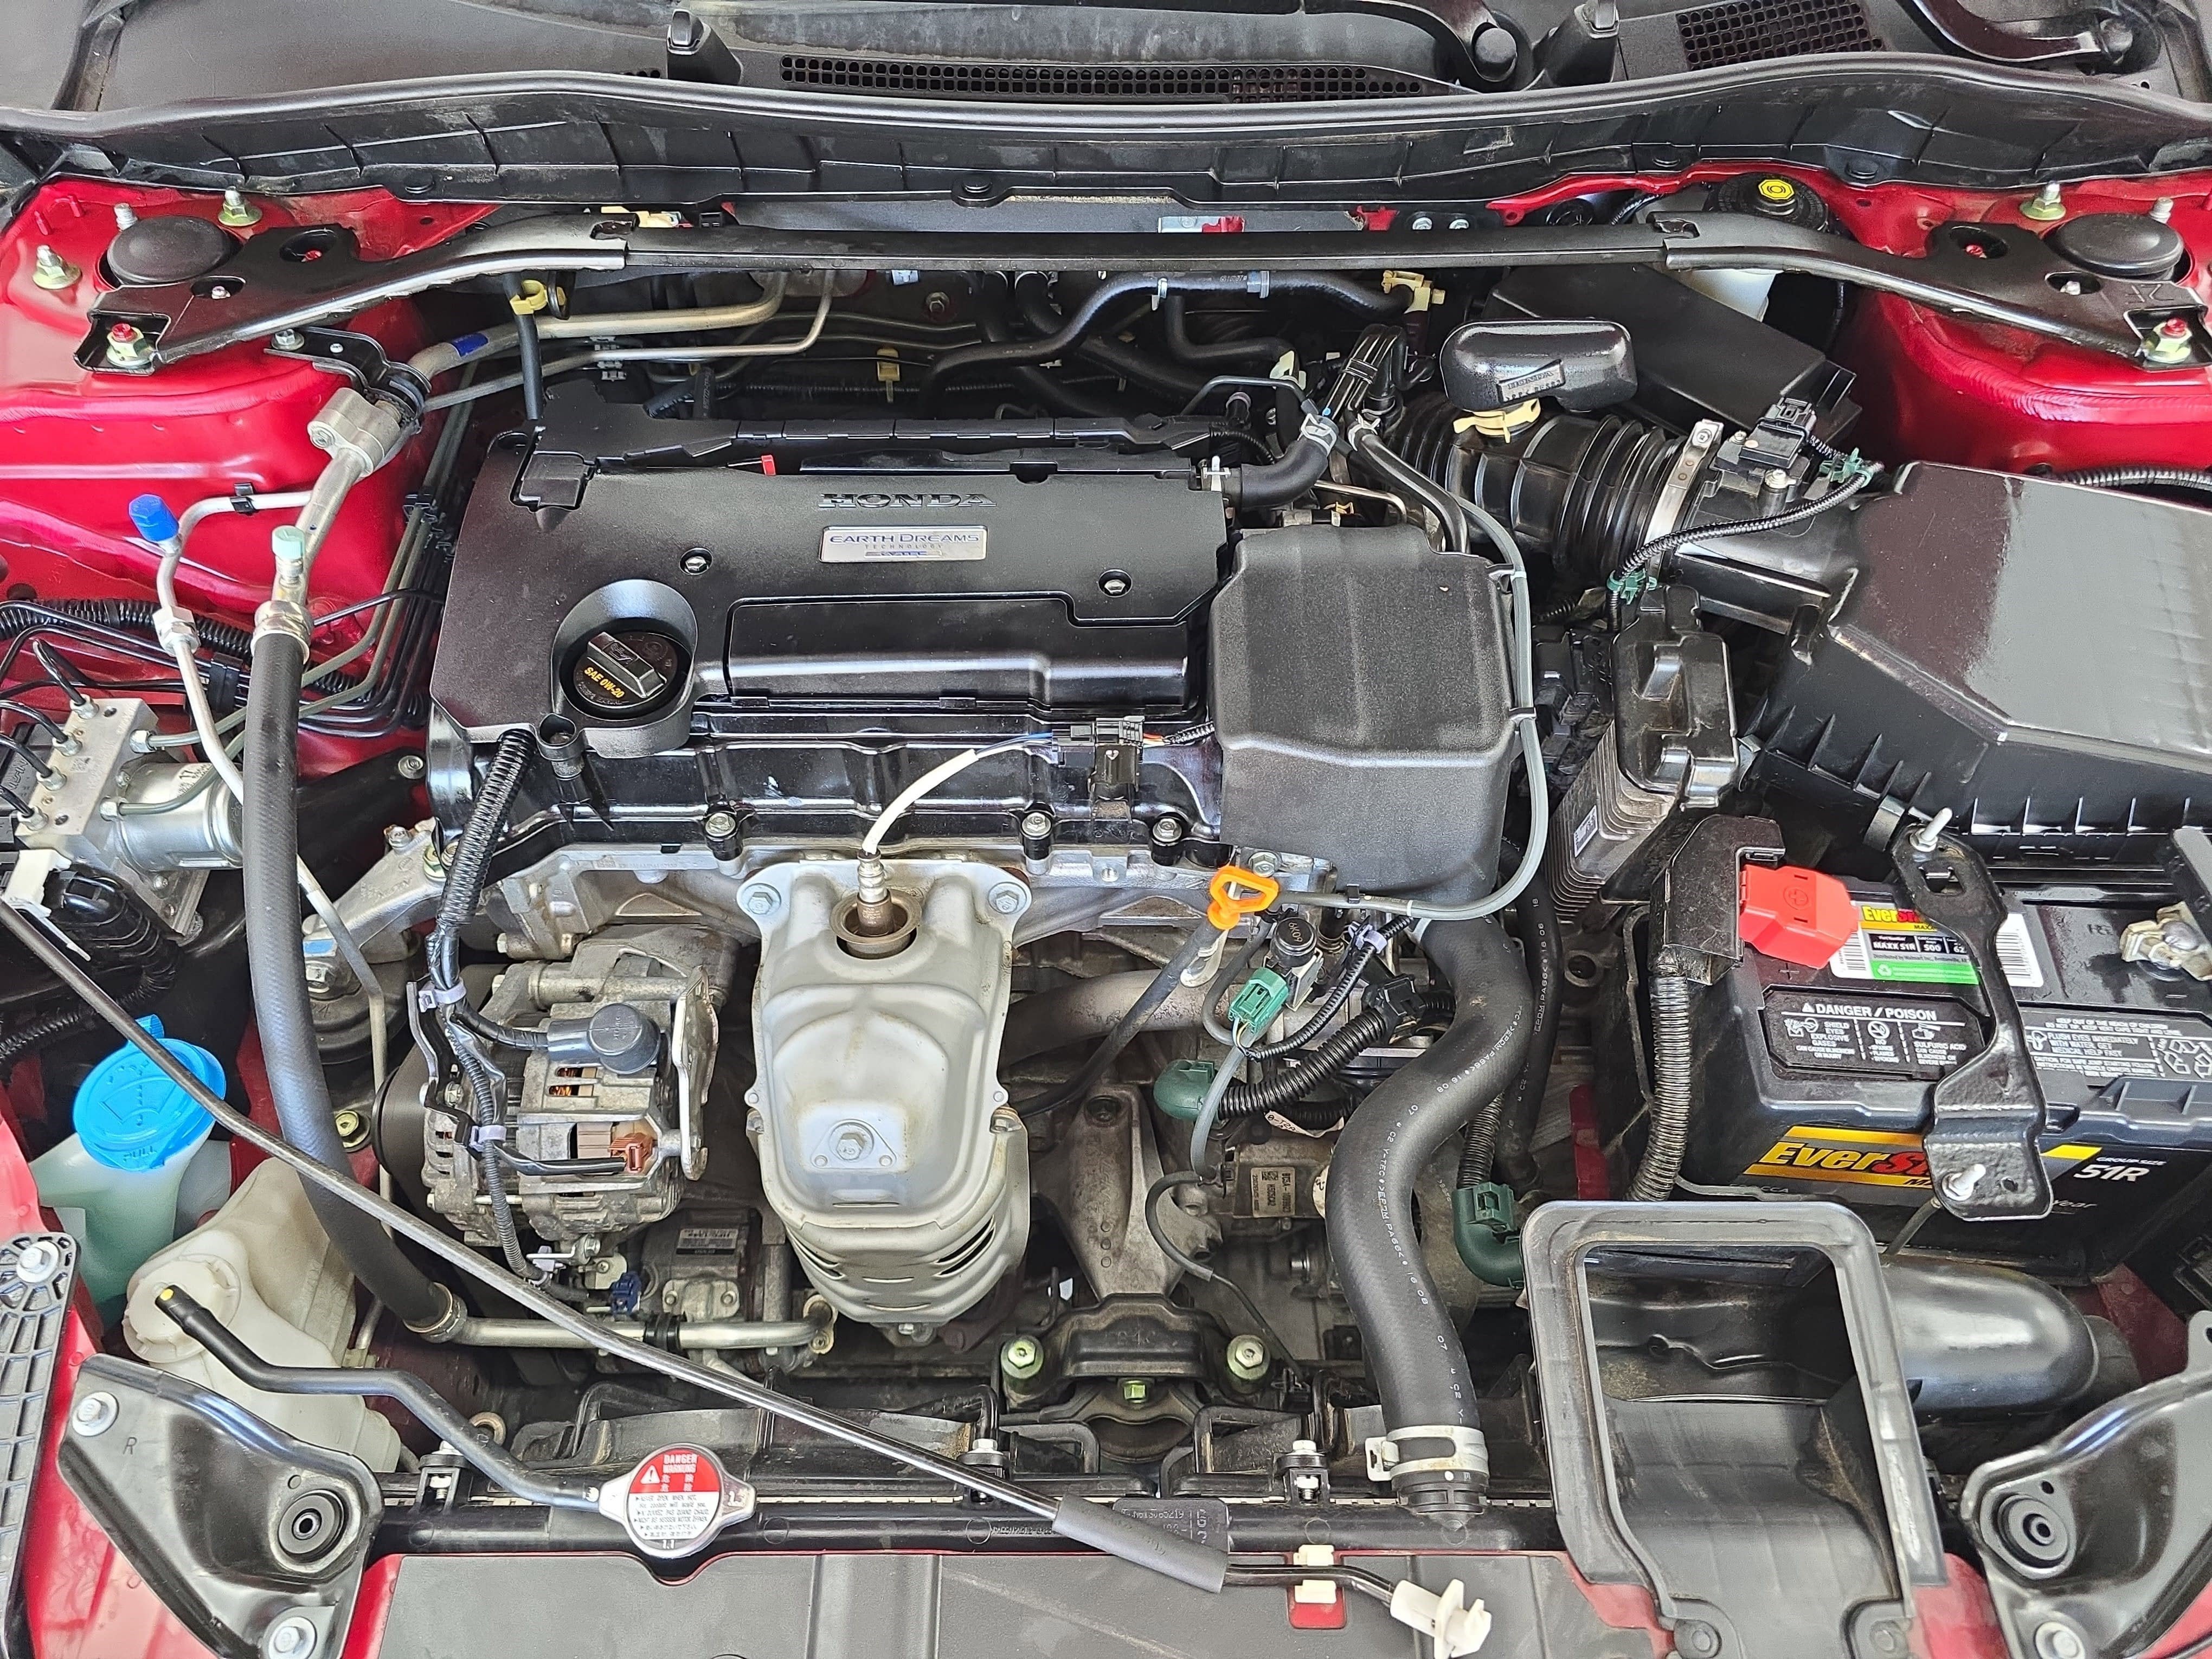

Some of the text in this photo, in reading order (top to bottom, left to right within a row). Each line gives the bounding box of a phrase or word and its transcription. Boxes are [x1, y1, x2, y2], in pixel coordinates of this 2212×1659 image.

[1507, 371, 1554, 390] HONDA
[819, 493, 997, 508] HONDA
[900, 534, 979, 543] DREAMS
[584, 667, 604, 682] SAE
[599, 678, 625, 698] 0W-20
[1288, 922, 1303, 942] 6K09
[1873, 941, 1917, 951] MAXX 51R
[1923, 943, 1942, 952] 500
[1953, 946, 1967, 954] 62
[1815, 1003, 1937, 1021] DANGER / POISON
[1810, 1033, 1850, 1041] EXPLOSIVE
[2071, 1033, 2091, 1041] EYES
[2091, 1034, 2138, 1045] IMMEDIATELY
[1913, 1041, 1949, 1050] SULFURIC
[2051, 1046, 2085, 1055] MEDICAL
[2097, 1042, 2113, 1050] GET
[1386, 1131, 1397, 1143] C2
[1378, 1148, 1390, 1176] Y-TEC
[2073, 1164, 2150, 1182] 51R
[1437, 1335, 1448, 1351] 07
[123, 1436, 137, 1455] R
[663, 1453, 698, 1464] DANGER
[662, 1539, 676, 1549] 1.1
